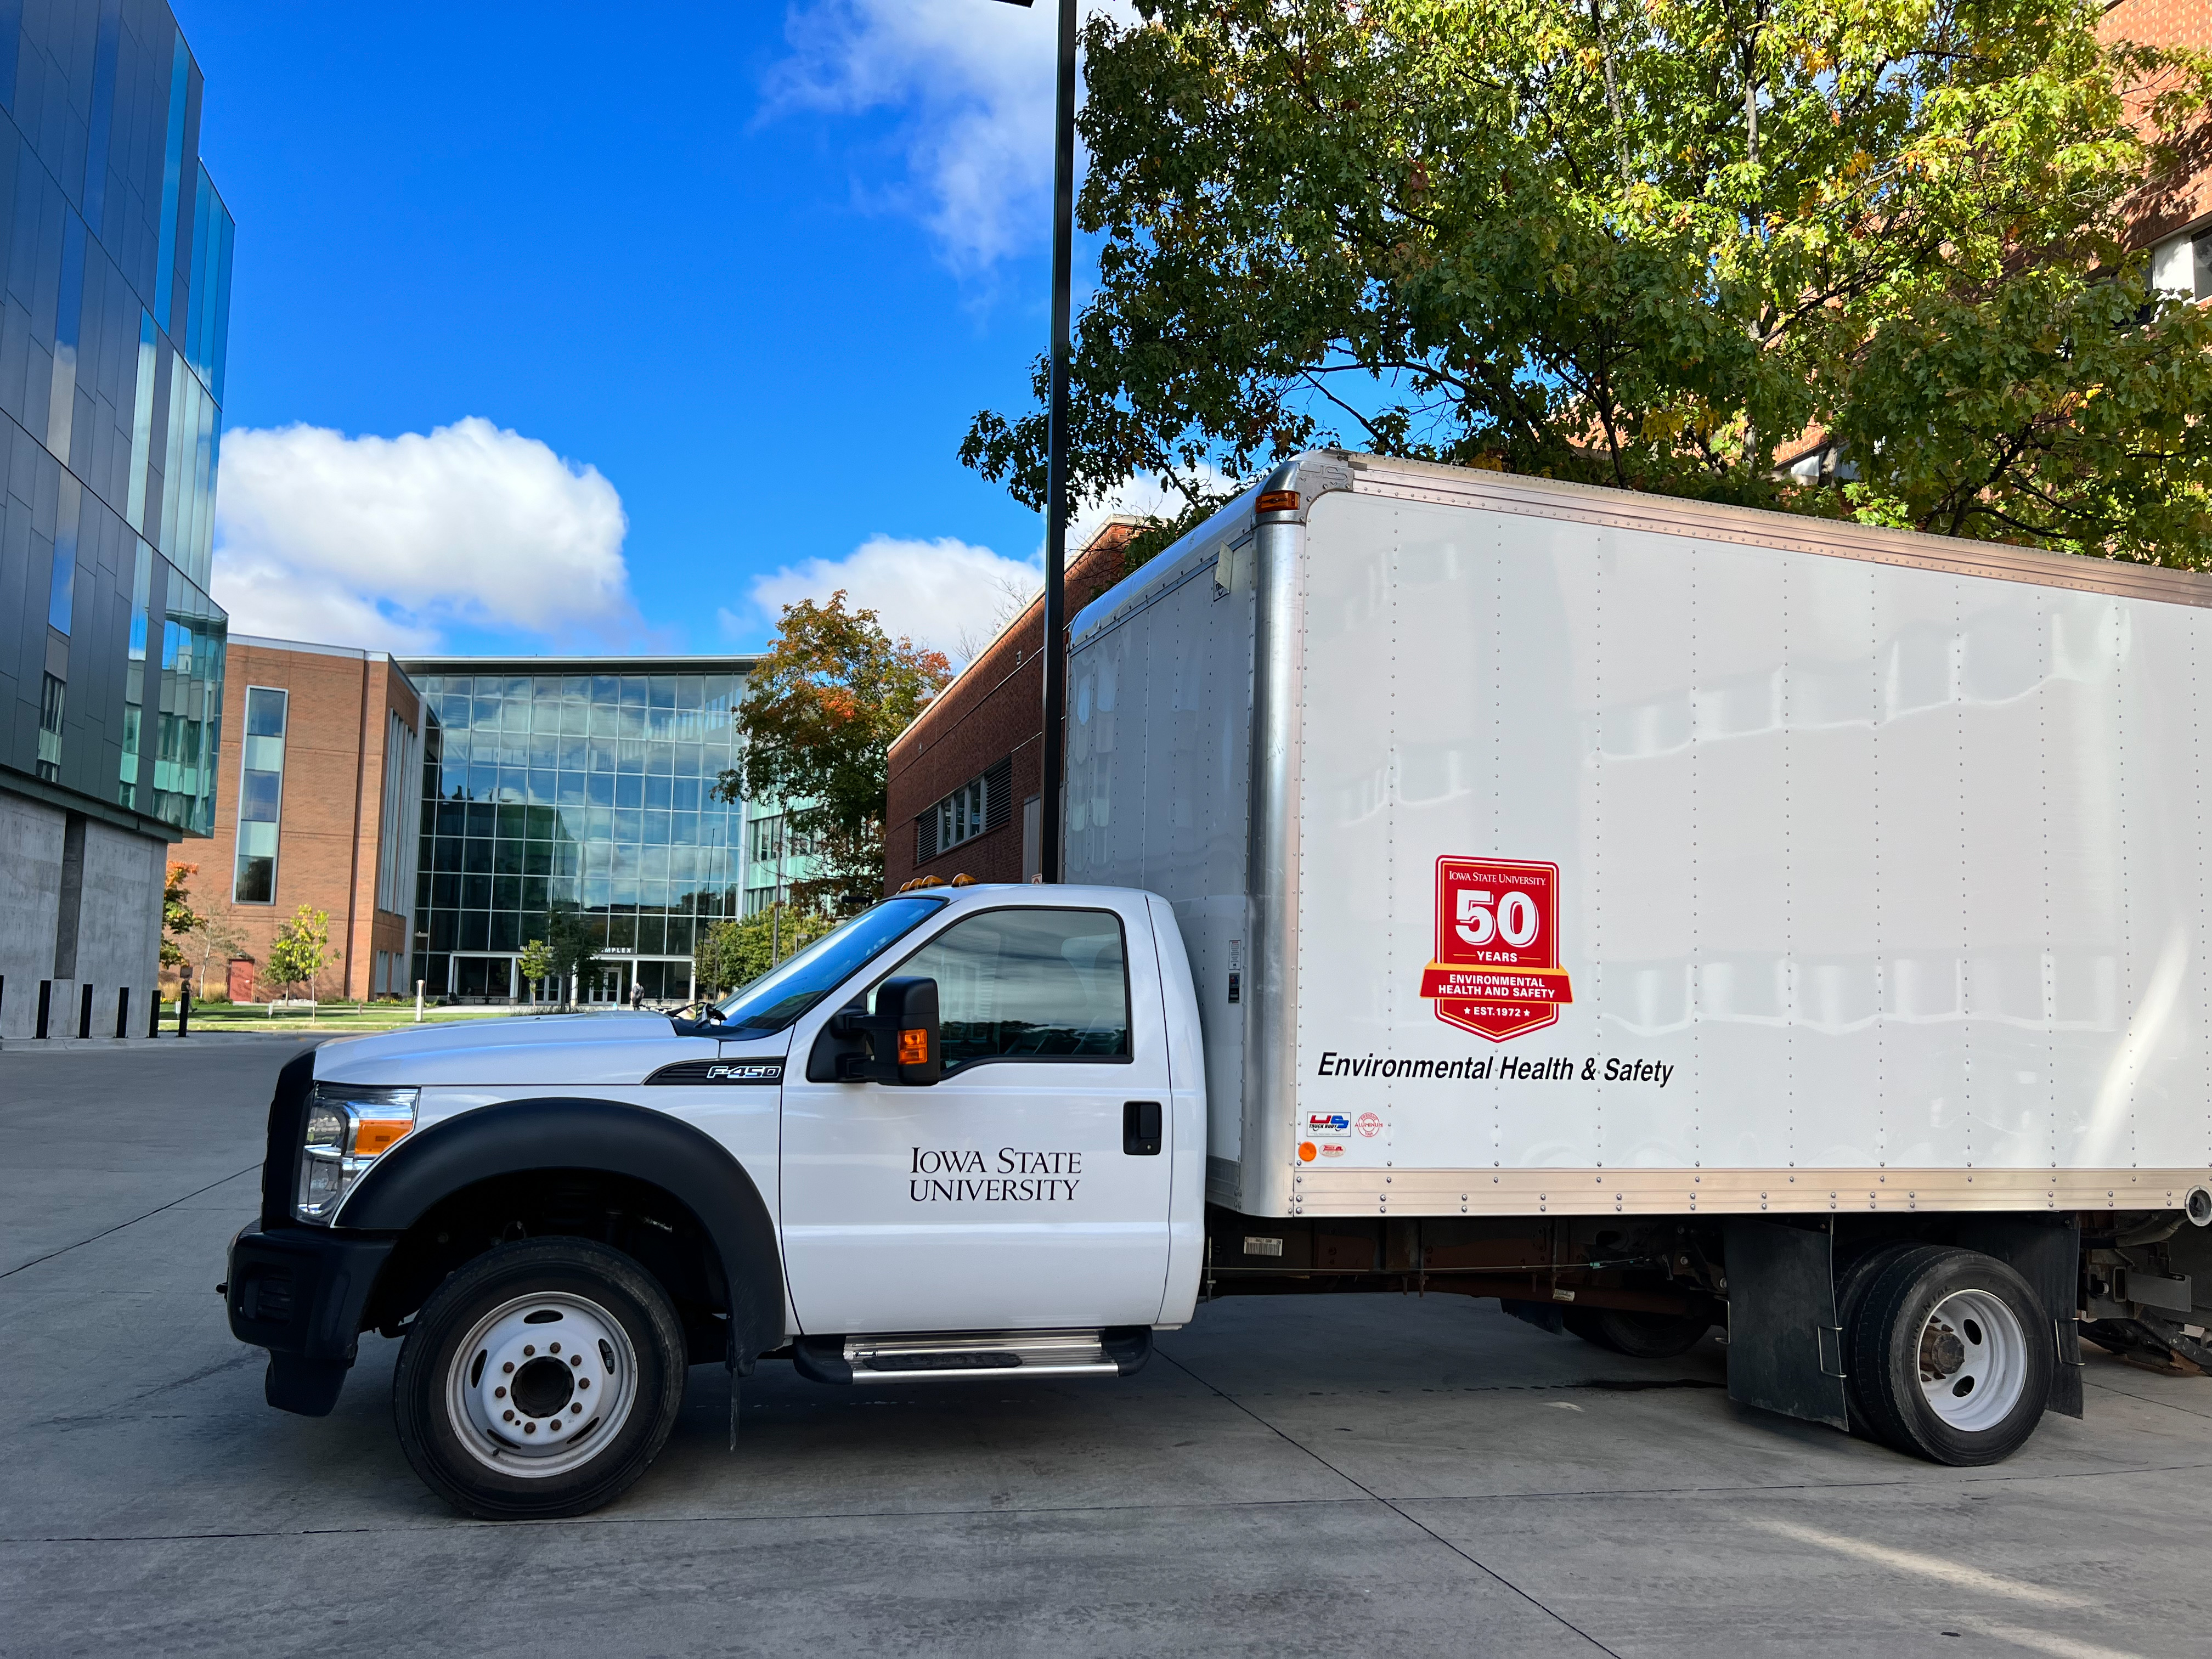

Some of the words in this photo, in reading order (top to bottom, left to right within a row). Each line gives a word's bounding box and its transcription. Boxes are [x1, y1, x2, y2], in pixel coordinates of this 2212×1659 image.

[1455, 889, 1539, 948] 50
[1476, 951, 1517, 962] YEARS
[1449, 974, 1545, 987] ENVIRONMENTAL
[1438, 984, 1481, 995] HEALTH
[1485, 986, 1509, 996] AND
[1513, 988, 1555, 998] SAFETY
[707, 1066, 781, 1079] F-450
[1318, 1052, 1494, 1079] Environmental
[1499, 1056, 1573, 1080] Health
[1581, 1057, 1597, 1081] &
[1604, 1058, 1674, 1088] Safety
[910, 1179, 1080, 1201] UNIVERSITY
